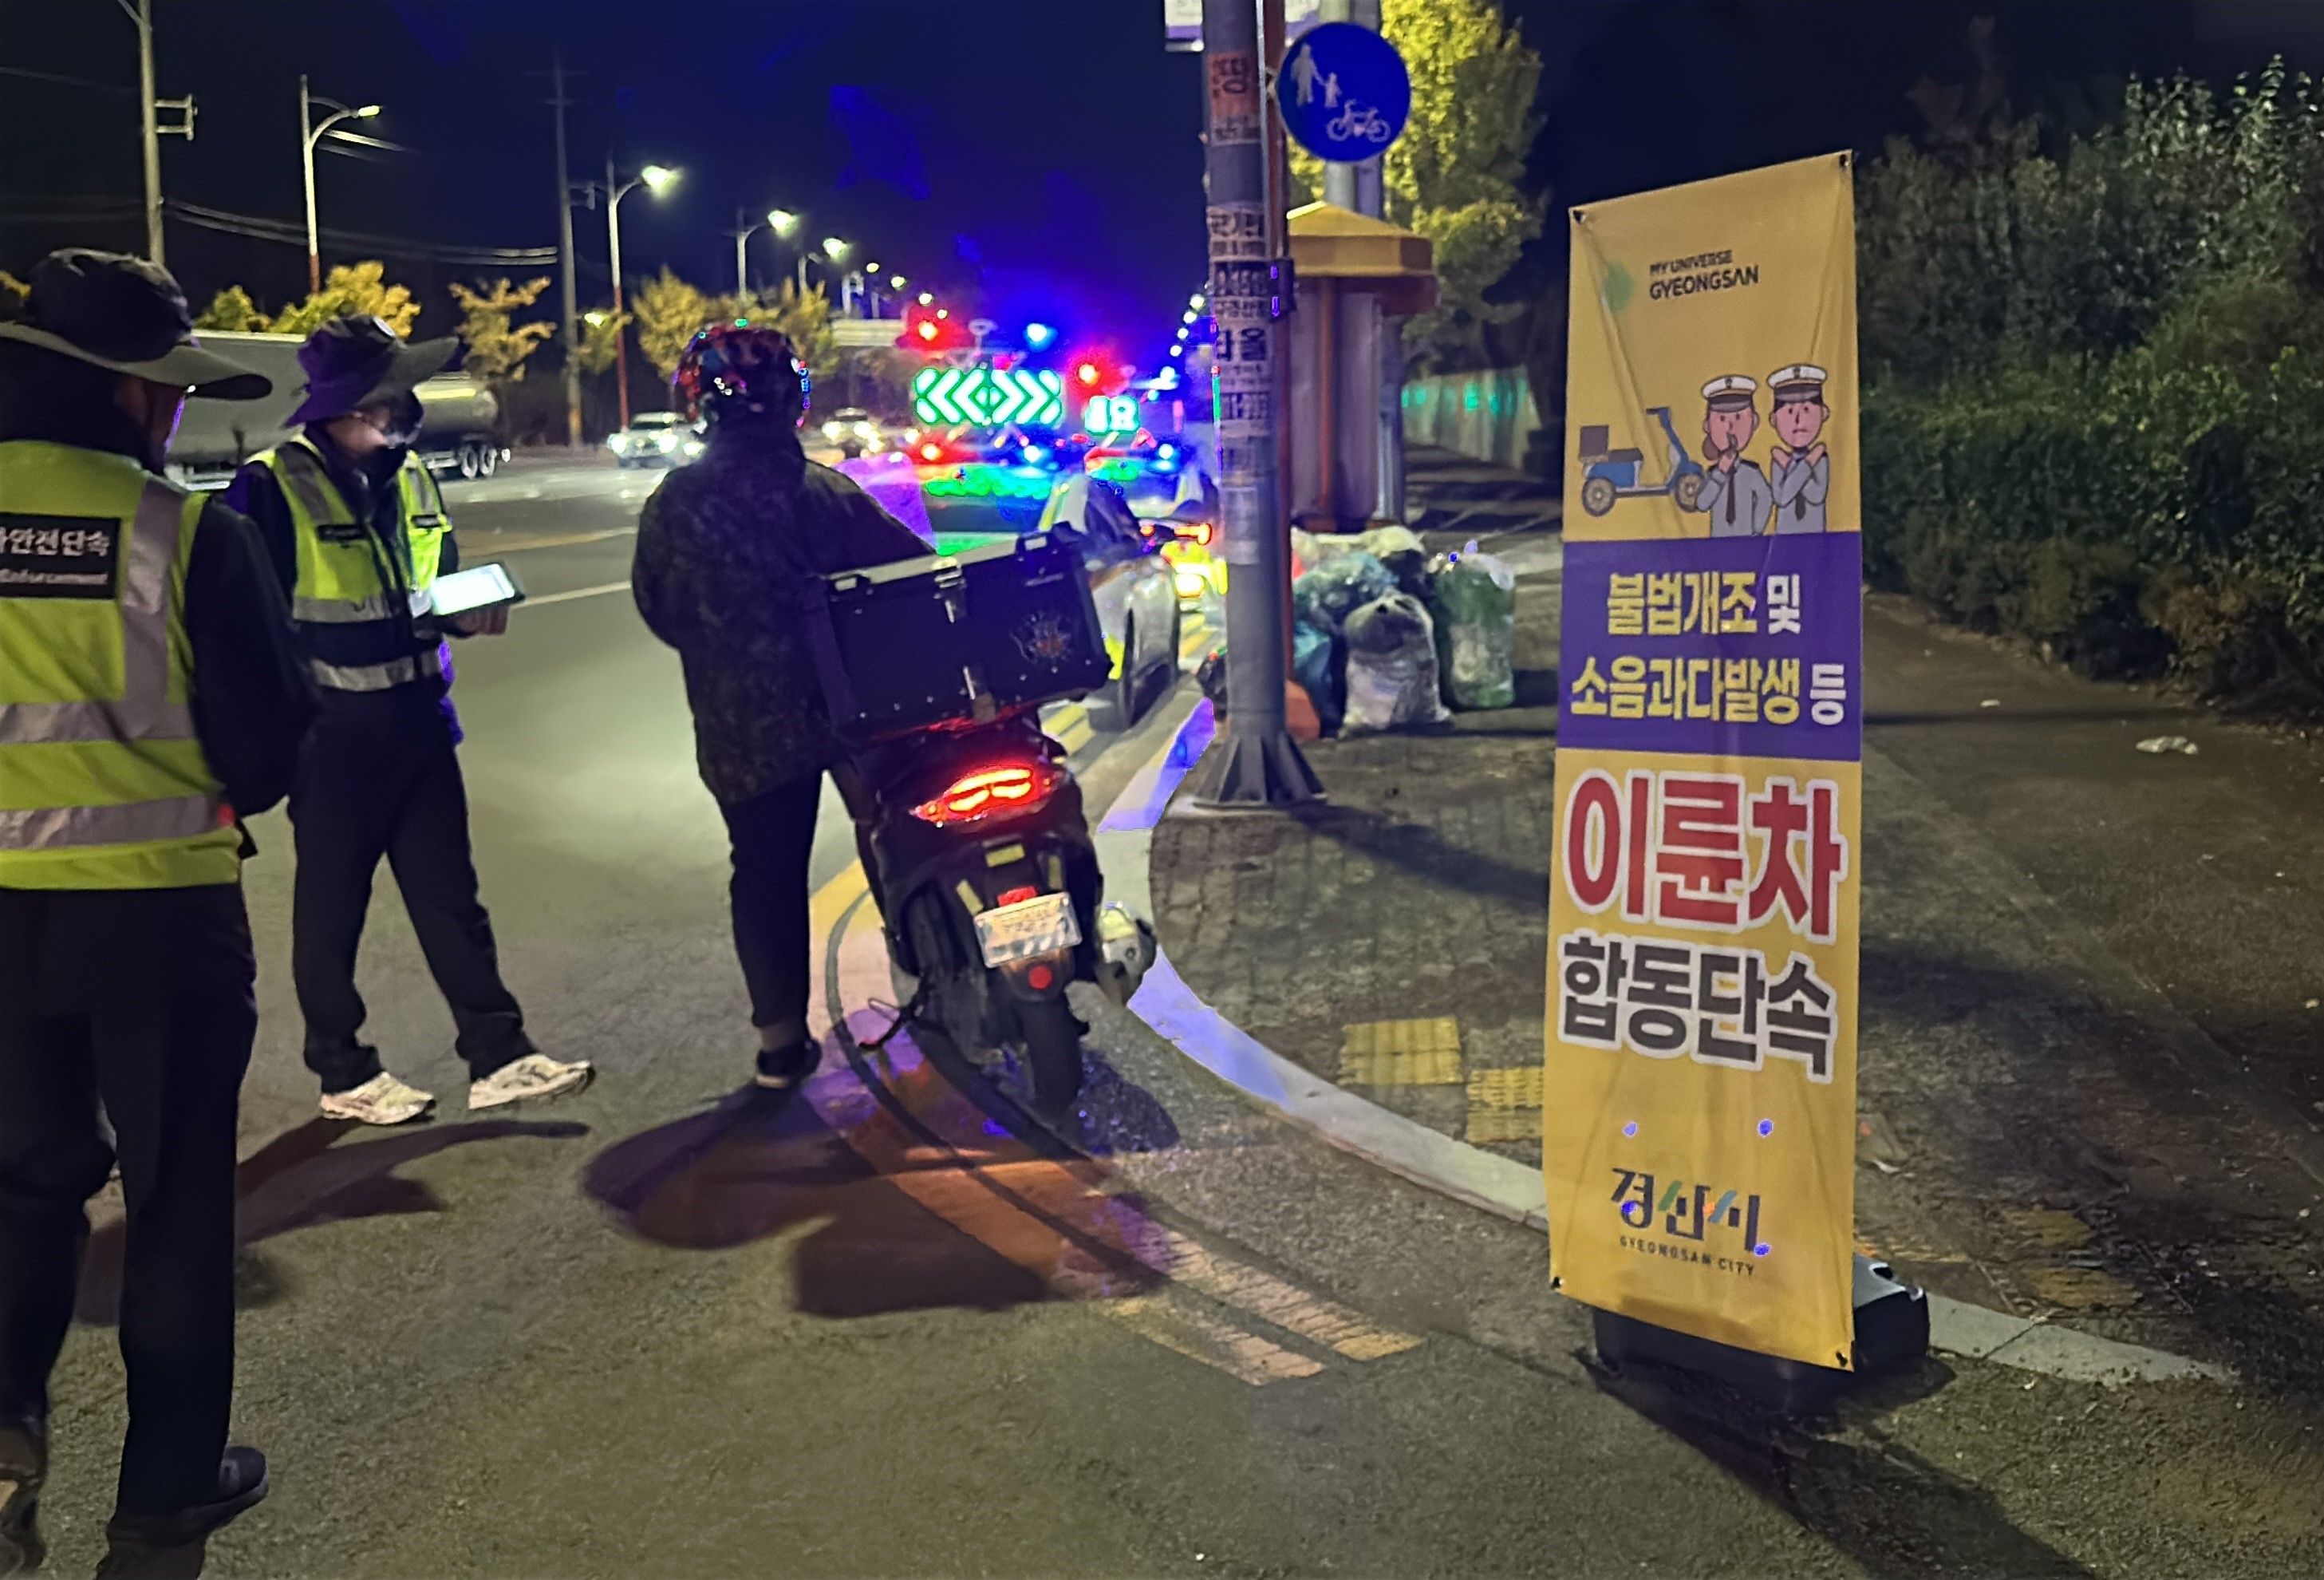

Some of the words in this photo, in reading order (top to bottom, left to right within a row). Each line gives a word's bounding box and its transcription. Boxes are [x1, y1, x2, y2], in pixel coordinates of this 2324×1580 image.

[1649, 263, 1668, 276] MY
[1670, 250, 1733, 273] UNIVERSE
[1649, 265, 1760, 301] GYEONGSAN
[1607, 571, 1758, 635] 불법개조
[1766, 573, 1801, 635] 및
[1570, 655, 1801, 725] 소음과다발생
[1809, 663, 1847, 725] 등
[1563, 768, 1847, 944] 이륜차
[1558, 929, 1838, 1084] 합동단속
[1610, 1167, 1760, 1253] 경산시
[1620, 1235, 1712, 1266] GYEONGSAN
[1718, 1258, 1755, 1277] CITY
